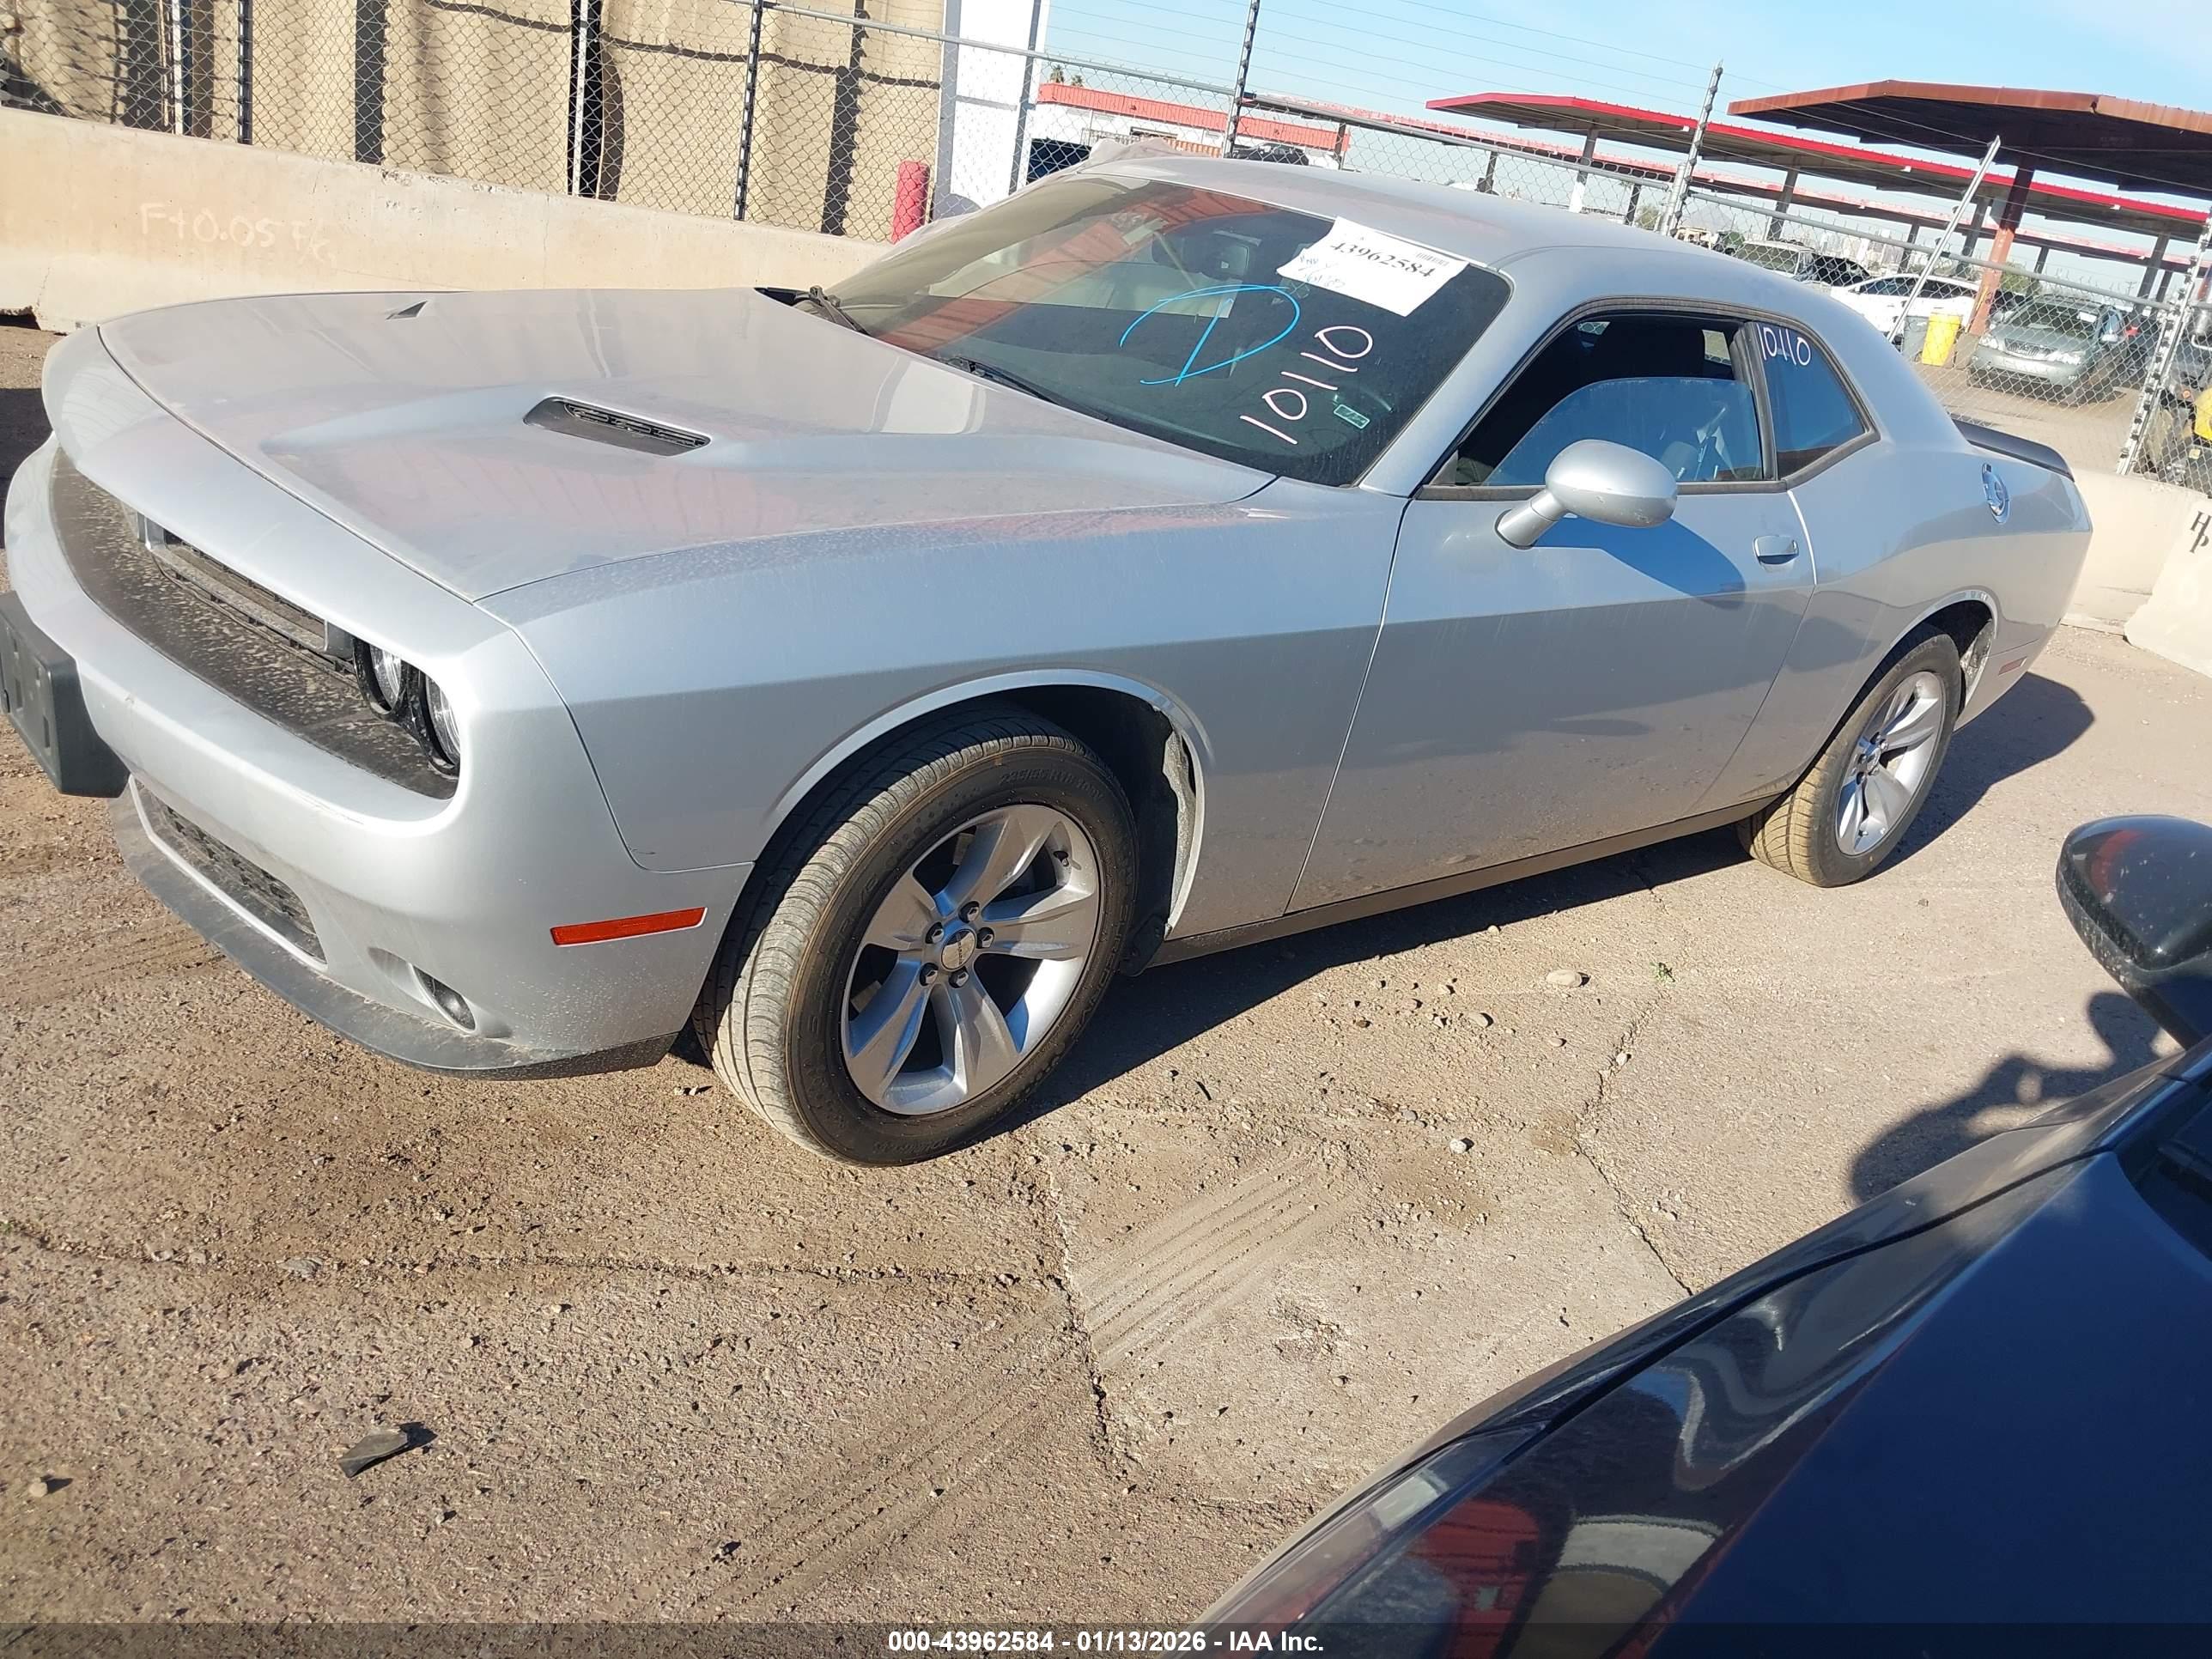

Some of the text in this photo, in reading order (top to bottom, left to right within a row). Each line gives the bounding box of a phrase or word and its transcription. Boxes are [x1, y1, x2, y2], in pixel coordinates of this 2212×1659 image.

[1330, 241, 1437, 278] 43962584
[1756, 322, 1811, 366] 10110
[1239, 325, 1374, 446] 10110
